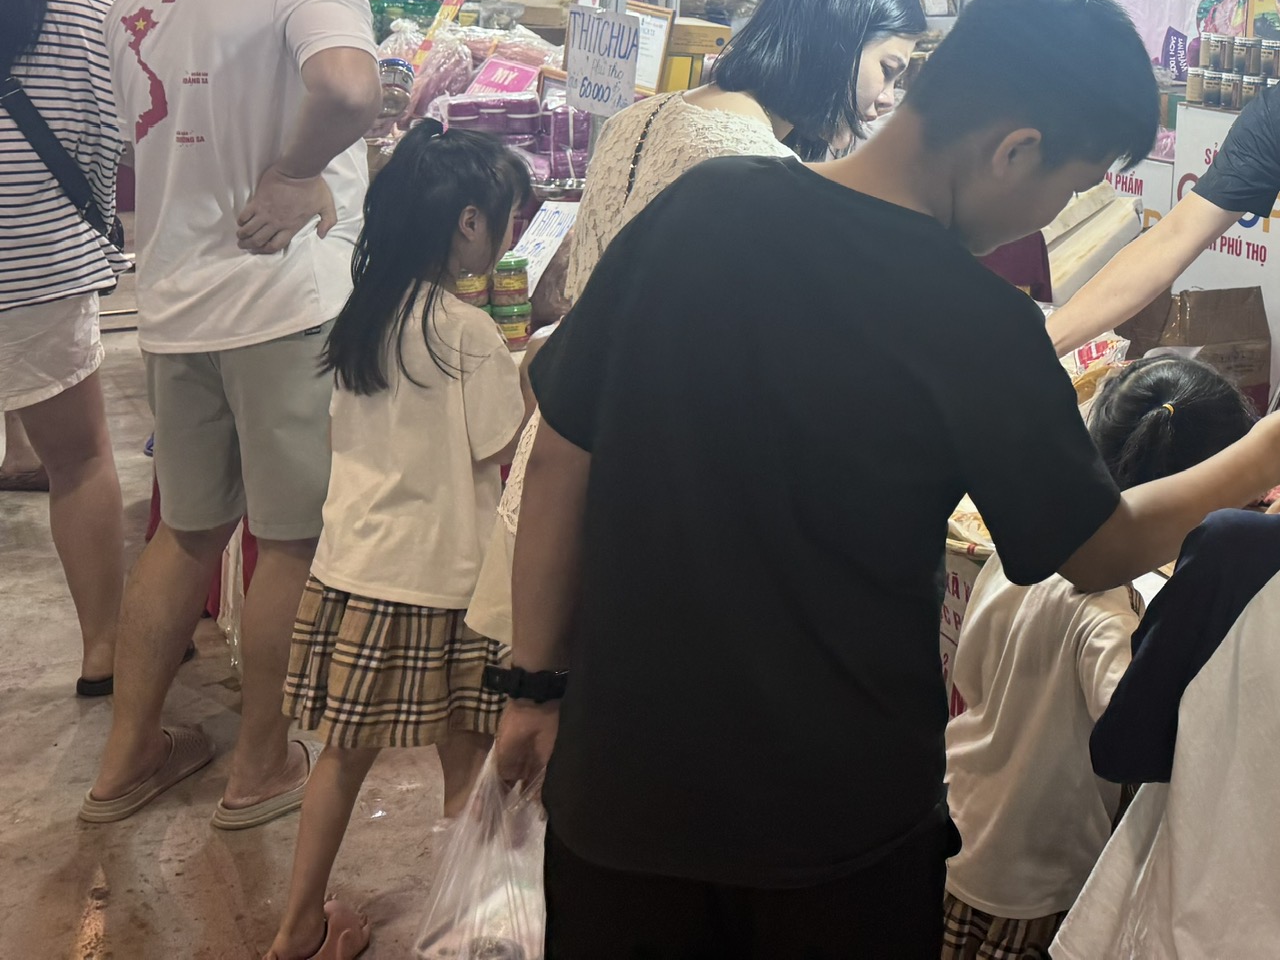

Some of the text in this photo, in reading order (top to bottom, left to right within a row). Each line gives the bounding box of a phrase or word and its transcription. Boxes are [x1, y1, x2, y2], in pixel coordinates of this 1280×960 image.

[1114, 170, 1143, 197] PHẨM
[1219, 235, 1267, 266] PHÚ THỌ
